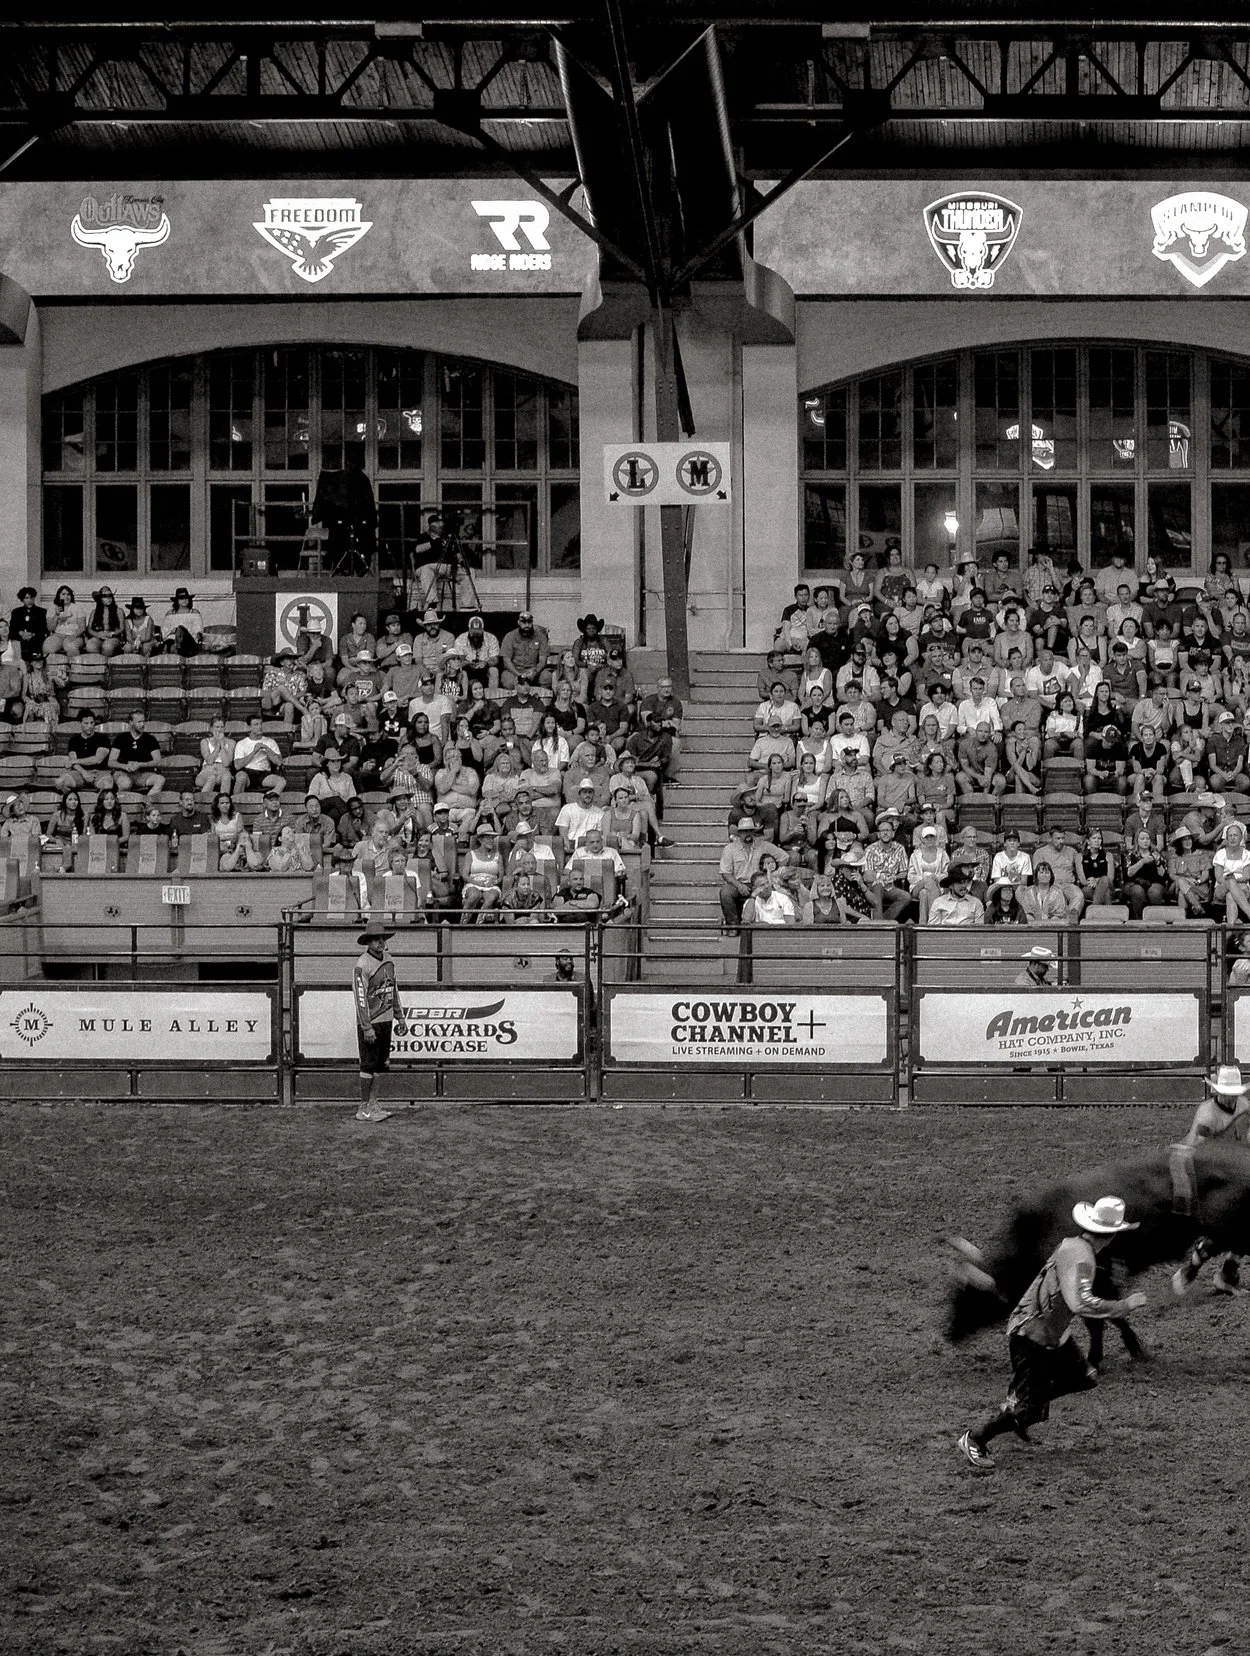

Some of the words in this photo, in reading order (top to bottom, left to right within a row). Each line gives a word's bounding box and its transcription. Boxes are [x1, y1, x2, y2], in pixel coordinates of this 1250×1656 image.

[270, 208, 355, 222] FREEDOM
[941, 209, 1004, 230] THUNDER
[470, 200, 551, 250] RR
[627, 459, 645, 489] L
[688, 460, 710, 487] M
[167, 887, 186, 903] EXIT
[411, 1009, 463, 1019] PBR
[671, 1002, 797, 1023] COWBOY
[24, 1018, 40, 1031] M
[79, 1018, 153, 1032] MULE
[169, 1019, 259, 1033] ALLEY
[985, 1004, 1132, 1041] American
[393, 1020, 518, 1045] OCKYARDS
[670, 1025, 798, 1043] CHANNEL
[998, 1038, 1025, 1050] HAT
[1027, 1031, 1096, 1048] COMPANY,
[1099, 1028, 1126, 1039] INC.
[672, 1046, 693, 1055] LIVE
[696, 1046, 753, 1056] STREAMING
[764, 1047, 779, 1056] ON
[782, 1047, 826, 1057] DEMAND
[1034, 1048, 1051, 1057] 1915
